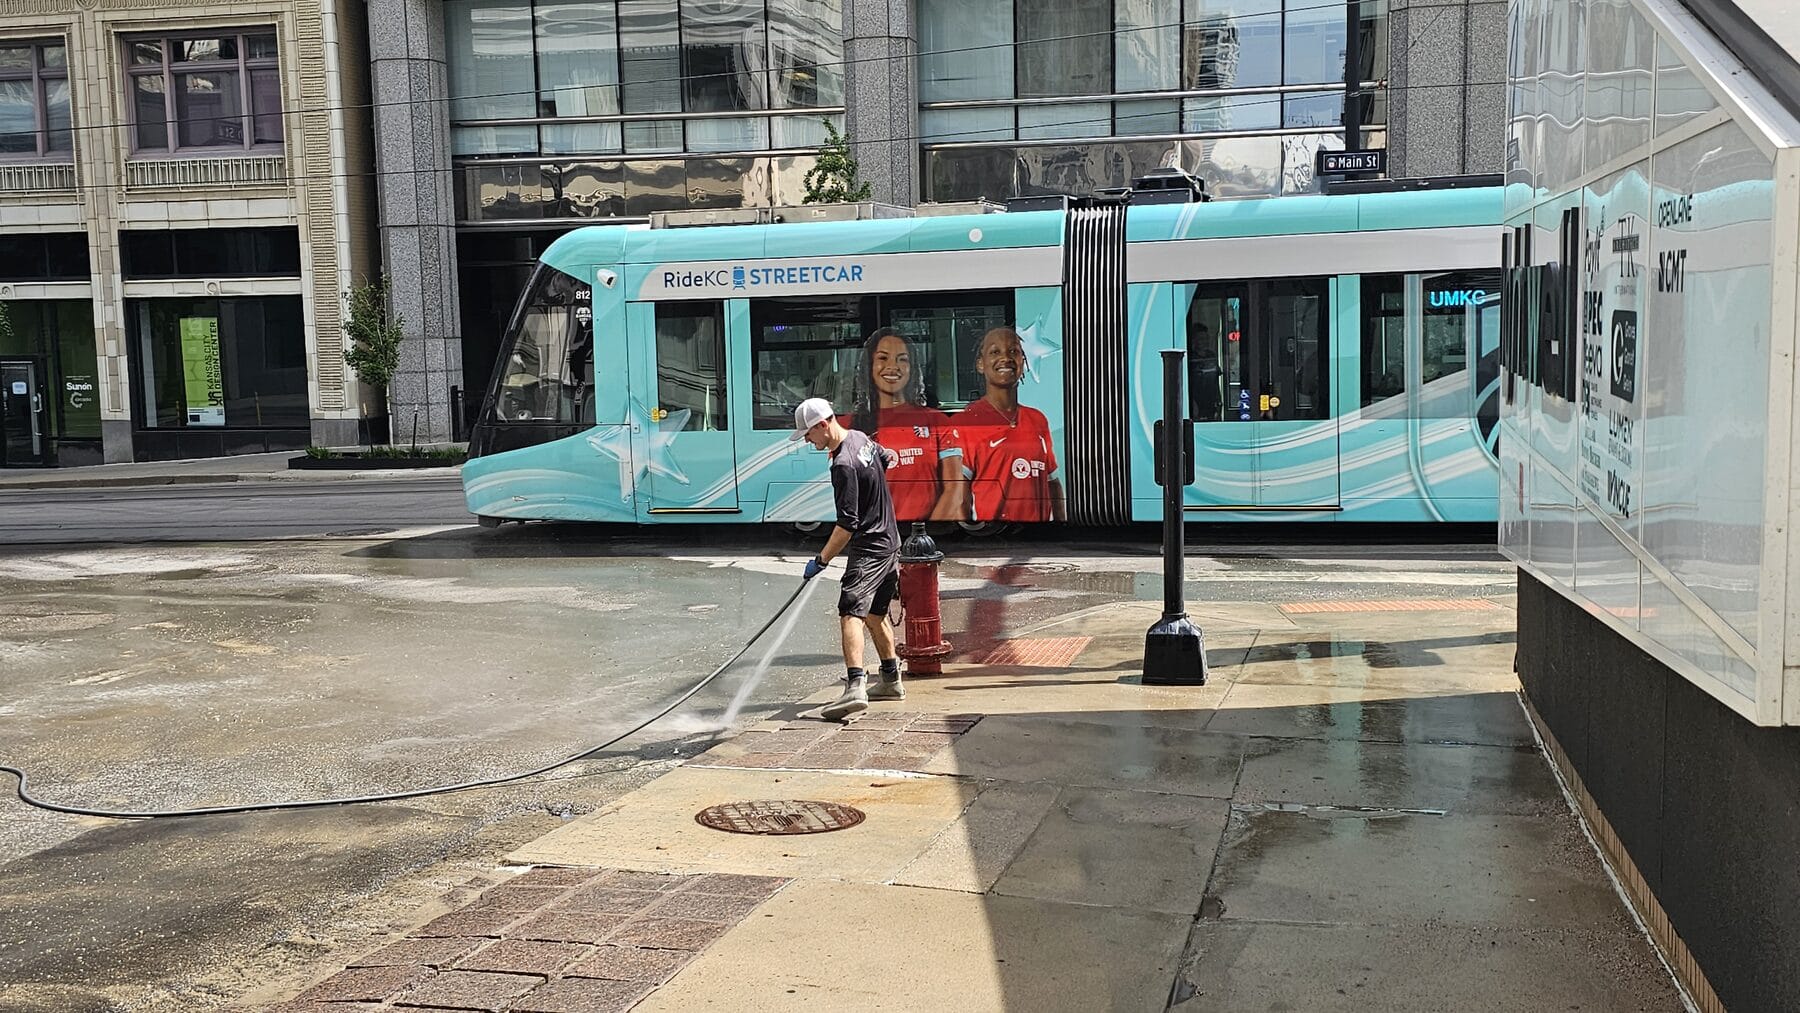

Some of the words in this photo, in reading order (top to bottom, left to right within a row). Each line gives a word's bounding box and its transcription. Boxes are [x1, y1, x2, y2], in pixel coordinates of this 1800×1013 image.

[1338, 155, 1362, 168] Main
[1366, 155, 1377, 167] St
[1658, 193, 1693, 229] OPENLANE
[664, 270, 729, 289] RideKC
[750, 265, 863, 285] STREETCAR
[575, 290, 591, 300] 812
[1430, 289, 1486, 307] UMKC
[203, 335, 212, 353] CITY
[209, 321, 219, 356] CENTER
[204, 353, 215, 390] KANSAS
[212, 358, 222, 390] DESIGN
[900, 447, 923, 457] UNITED
[900, 457, 915, 466] WAY
